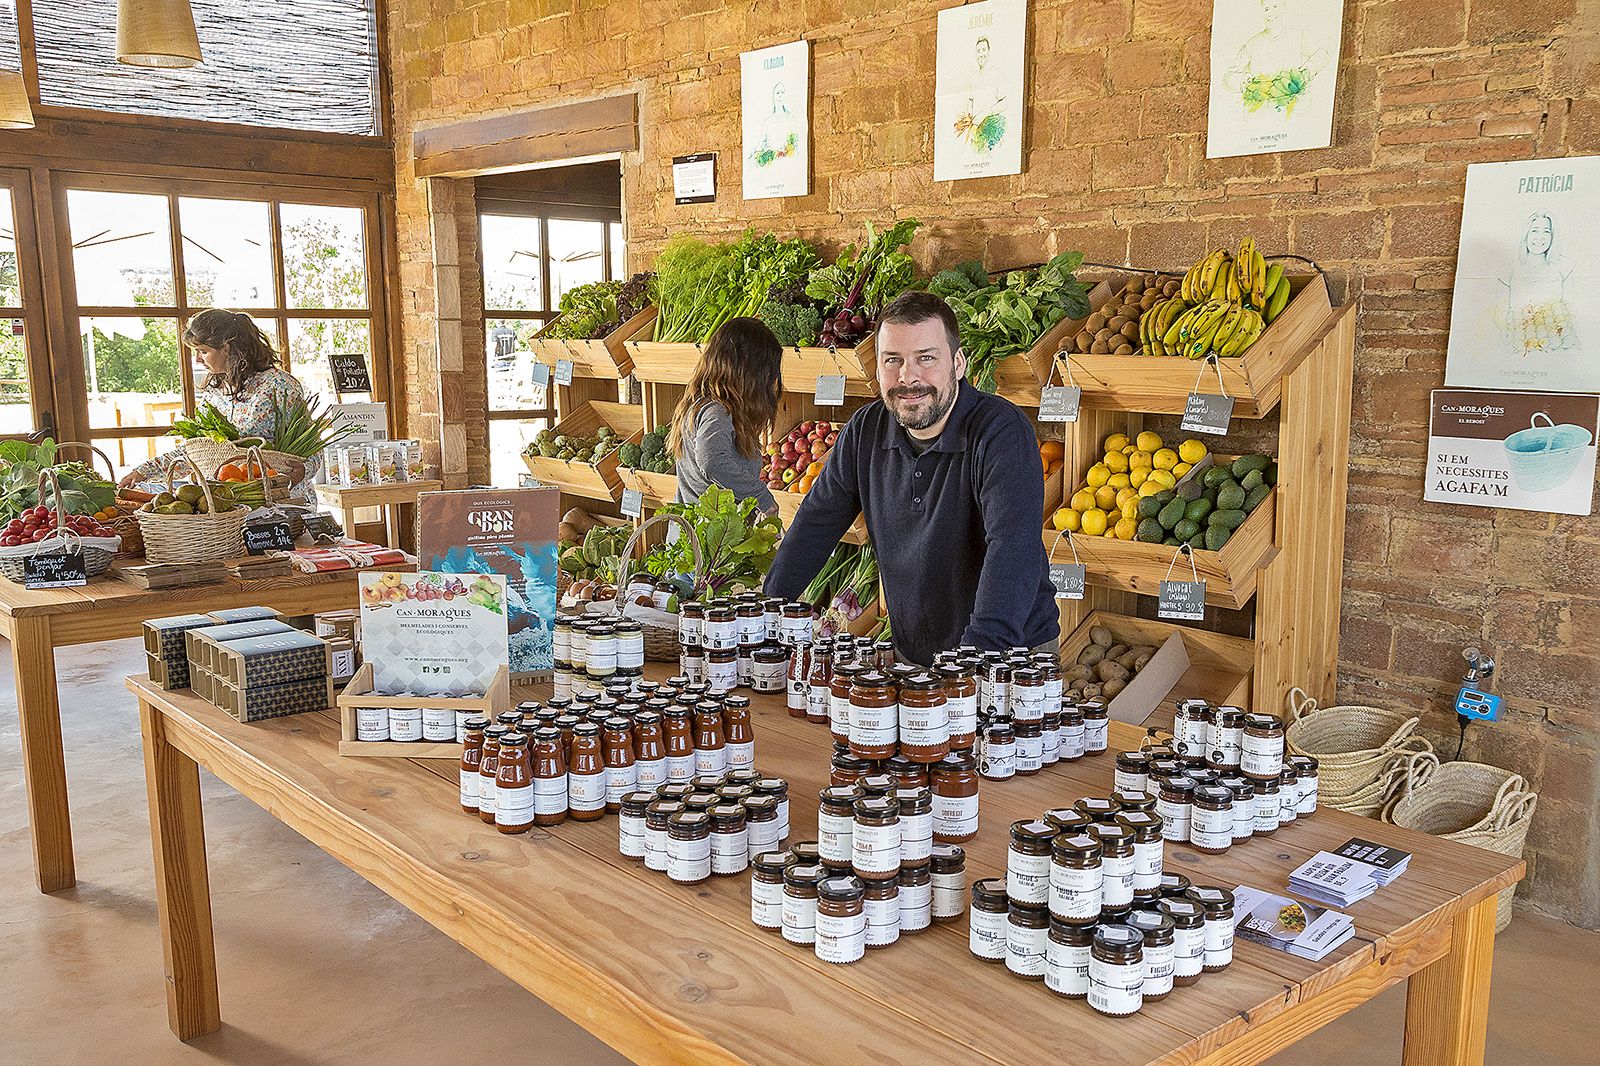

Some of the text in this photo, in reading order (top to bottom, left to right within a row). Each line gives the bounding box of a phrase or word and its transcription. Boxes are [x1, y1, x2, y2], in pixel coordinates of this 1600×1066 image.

[1518, 173, 1573, 194] PATRÍCIA
[1437, 454, 1469, 465] SI EM
[1436, 466, 1509, 480] NECESSITES
[1435, 480, 1508, 497] AGAFA'M
